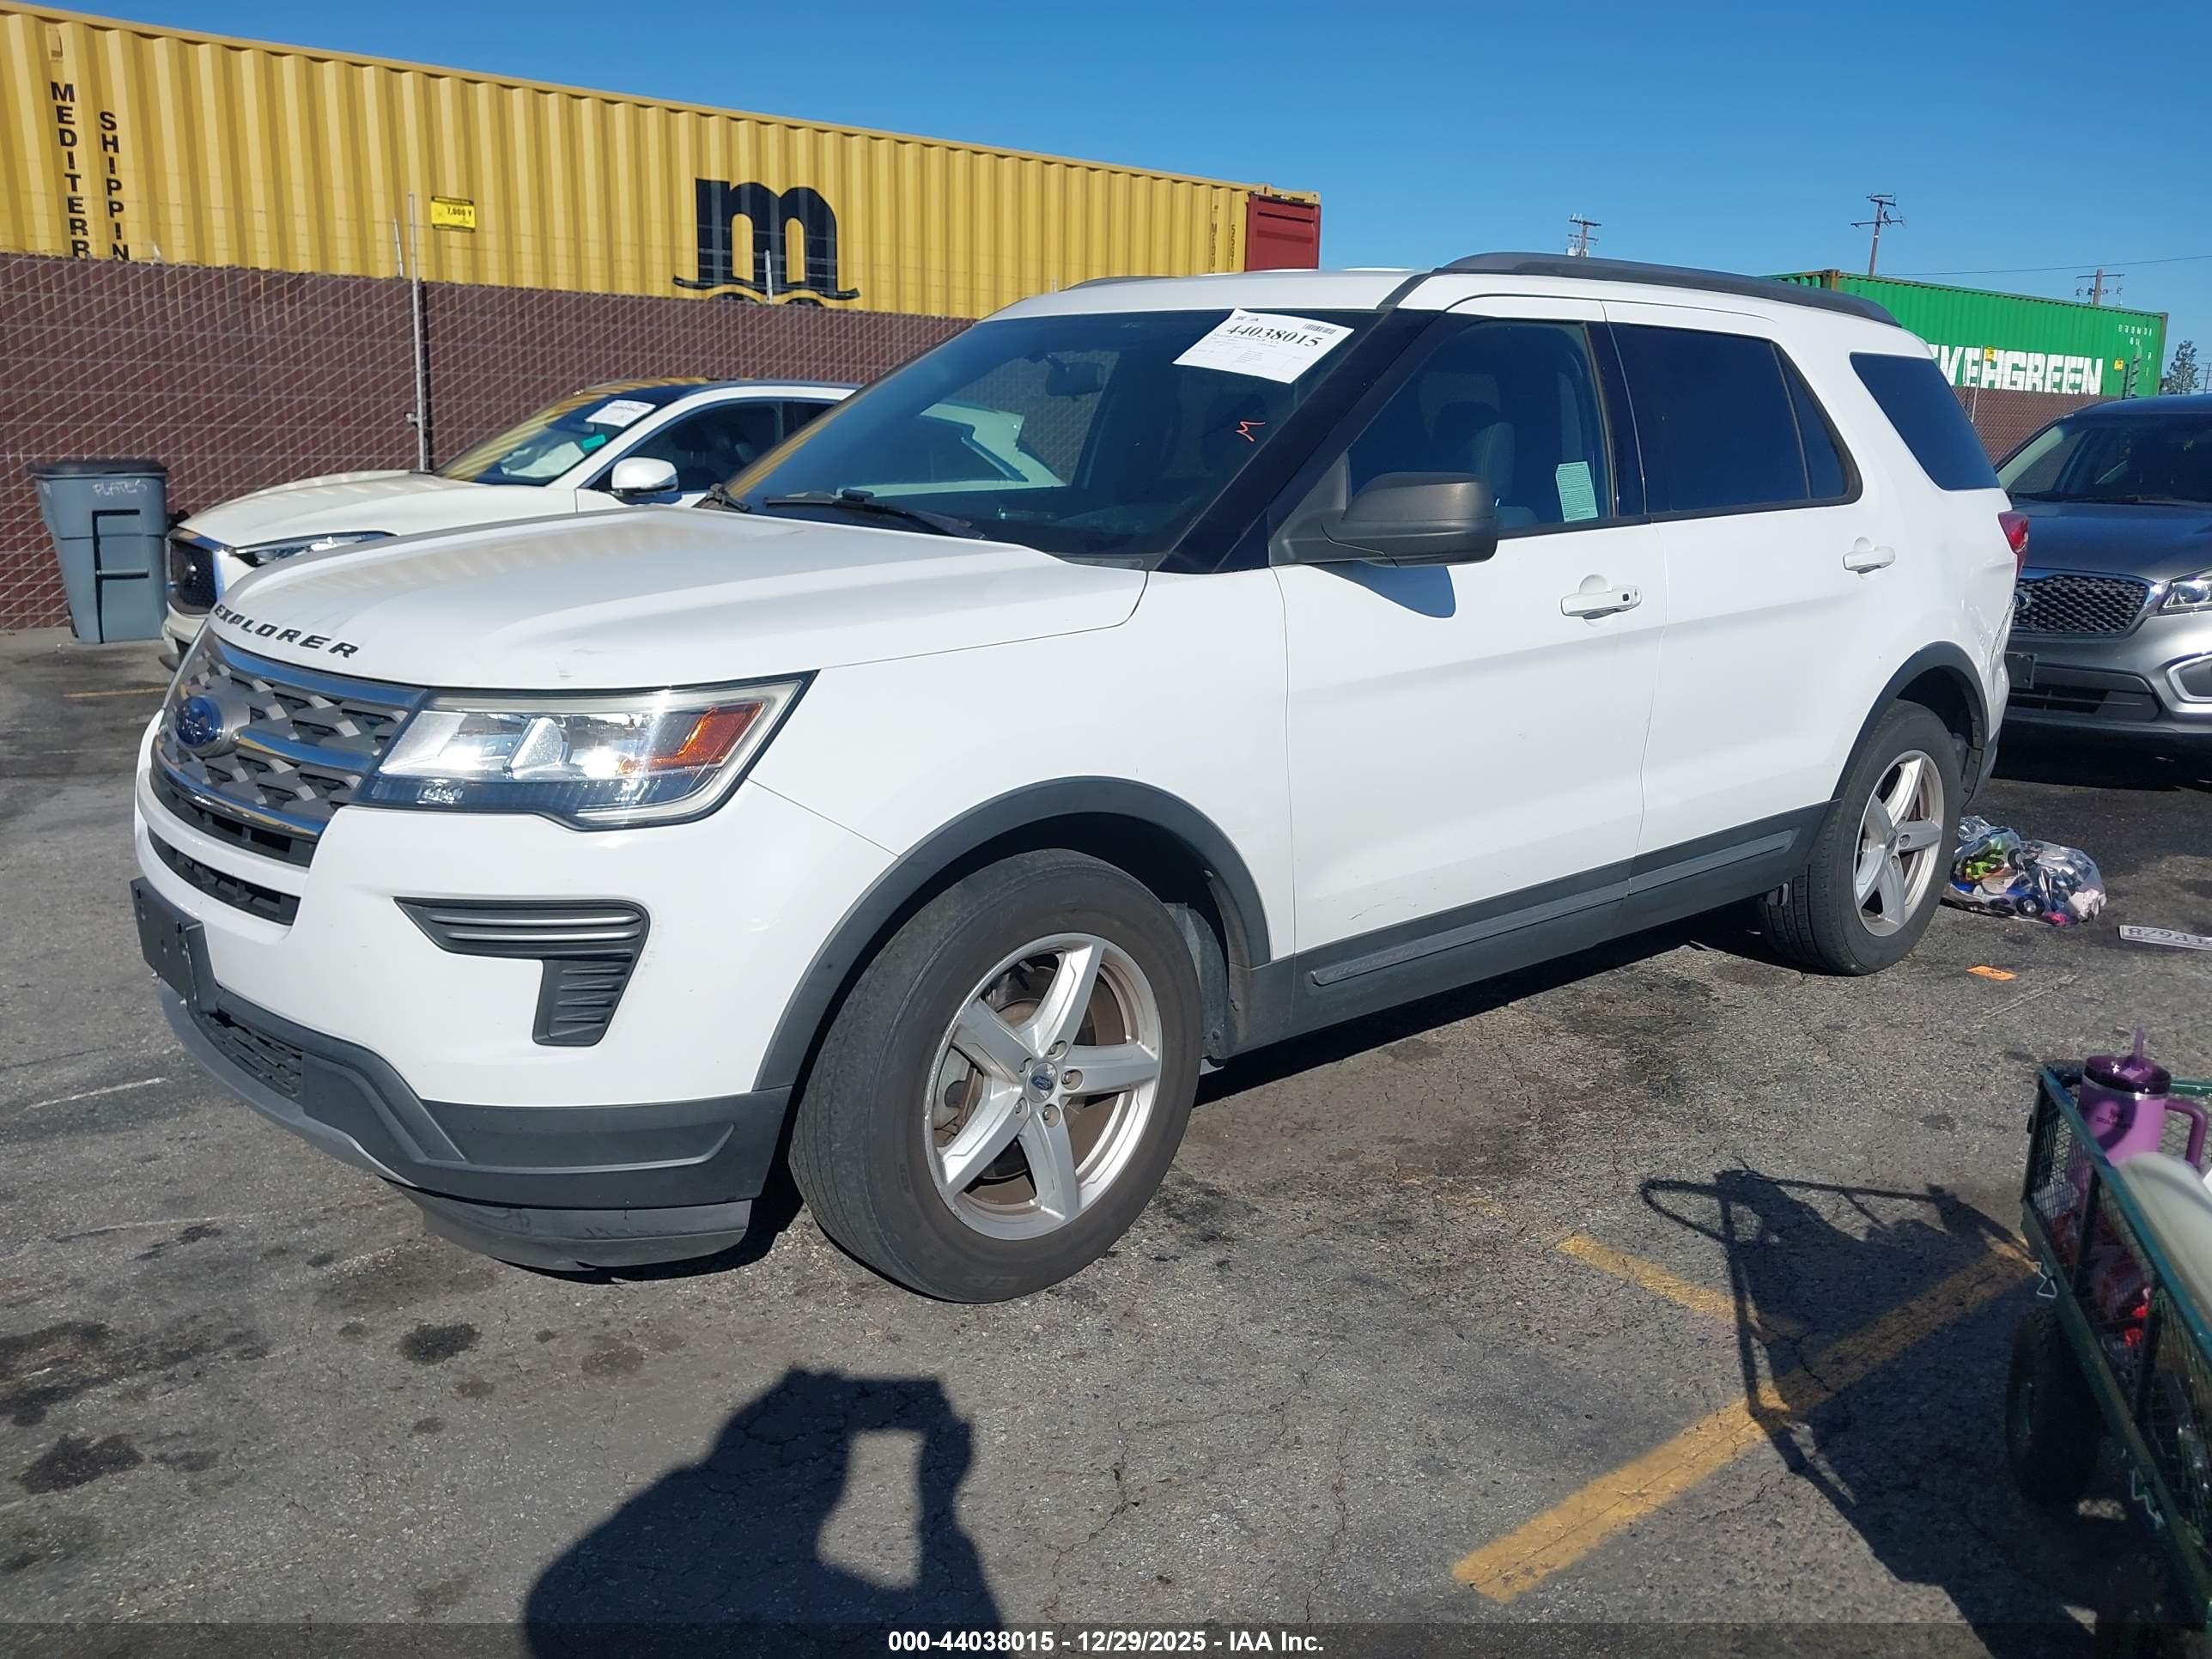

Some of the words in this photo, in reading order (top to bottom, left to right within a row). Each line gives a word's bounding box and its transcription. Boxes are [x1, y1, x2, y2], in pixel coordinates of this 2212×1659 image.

[51, 81, 90, 258] MEDITERR
[99, 111, 130, 261] SHIPPIN
[1225, 324, 1326, 348] 44038015
[214, 604, 360, 659] EXPLORER
